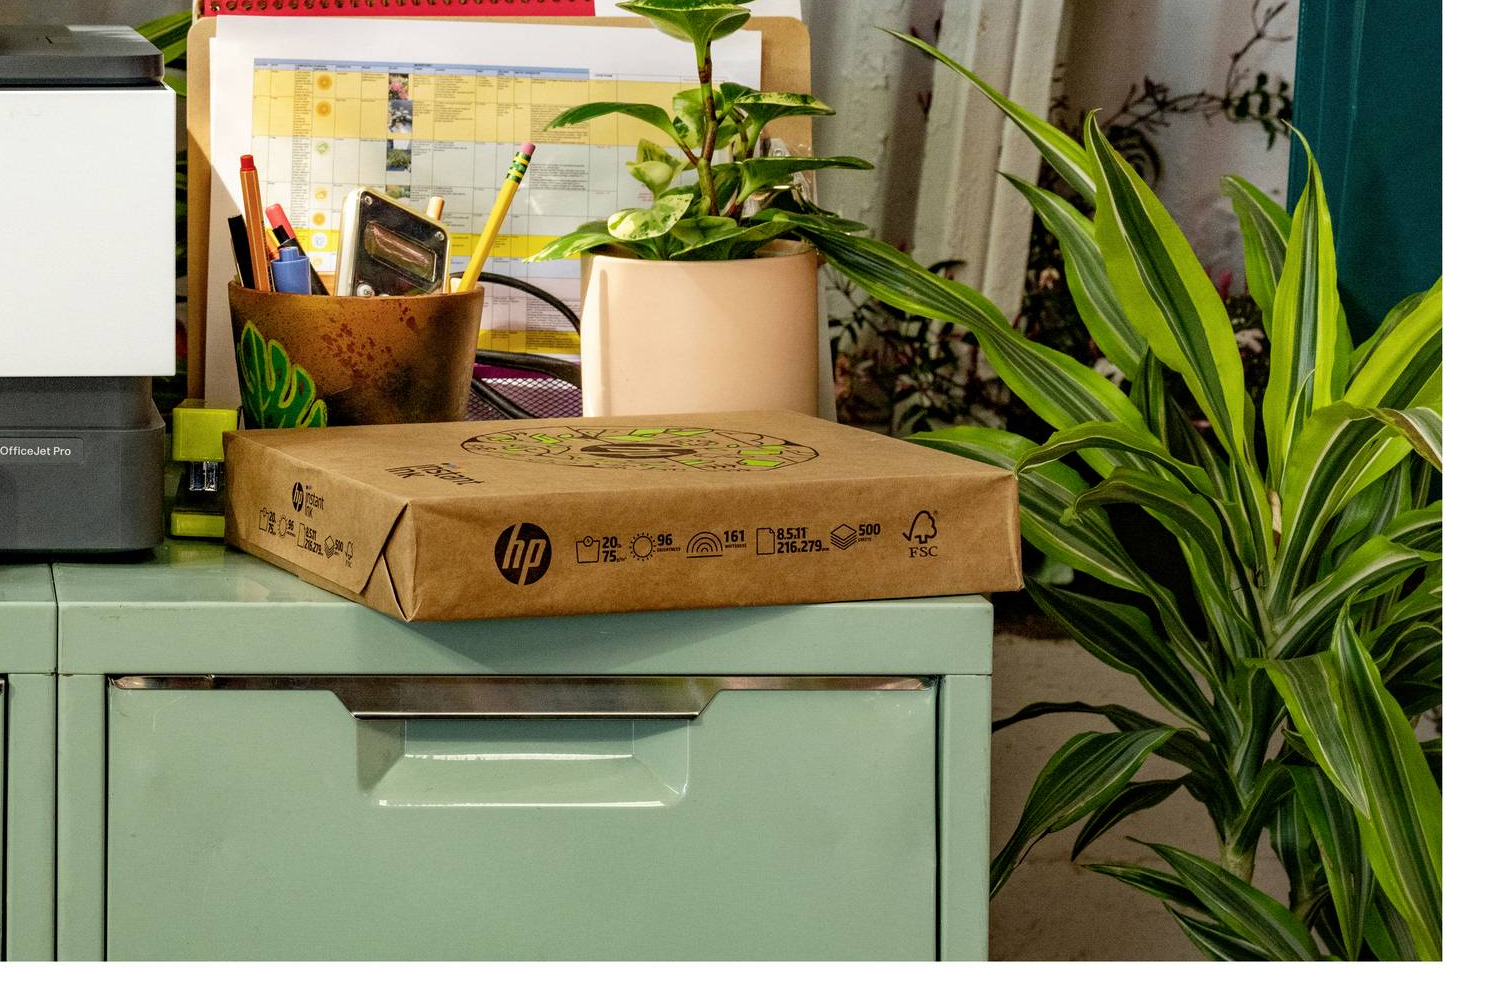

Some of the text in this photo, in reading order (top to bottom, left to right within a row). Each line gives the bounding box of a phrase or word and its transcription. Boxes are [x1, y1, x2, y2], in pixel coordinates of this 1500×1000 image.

[0, 445, 51, 456] OfficeJet
[53, 446, 72, 456] Pro
[858, 523, 881, 536] 500
[657, 533, 673, 546] 96
[723, 530, 746, 543] 161
[498, 522, 550, 586] hp
[908, 545, 939, 558] FSC
